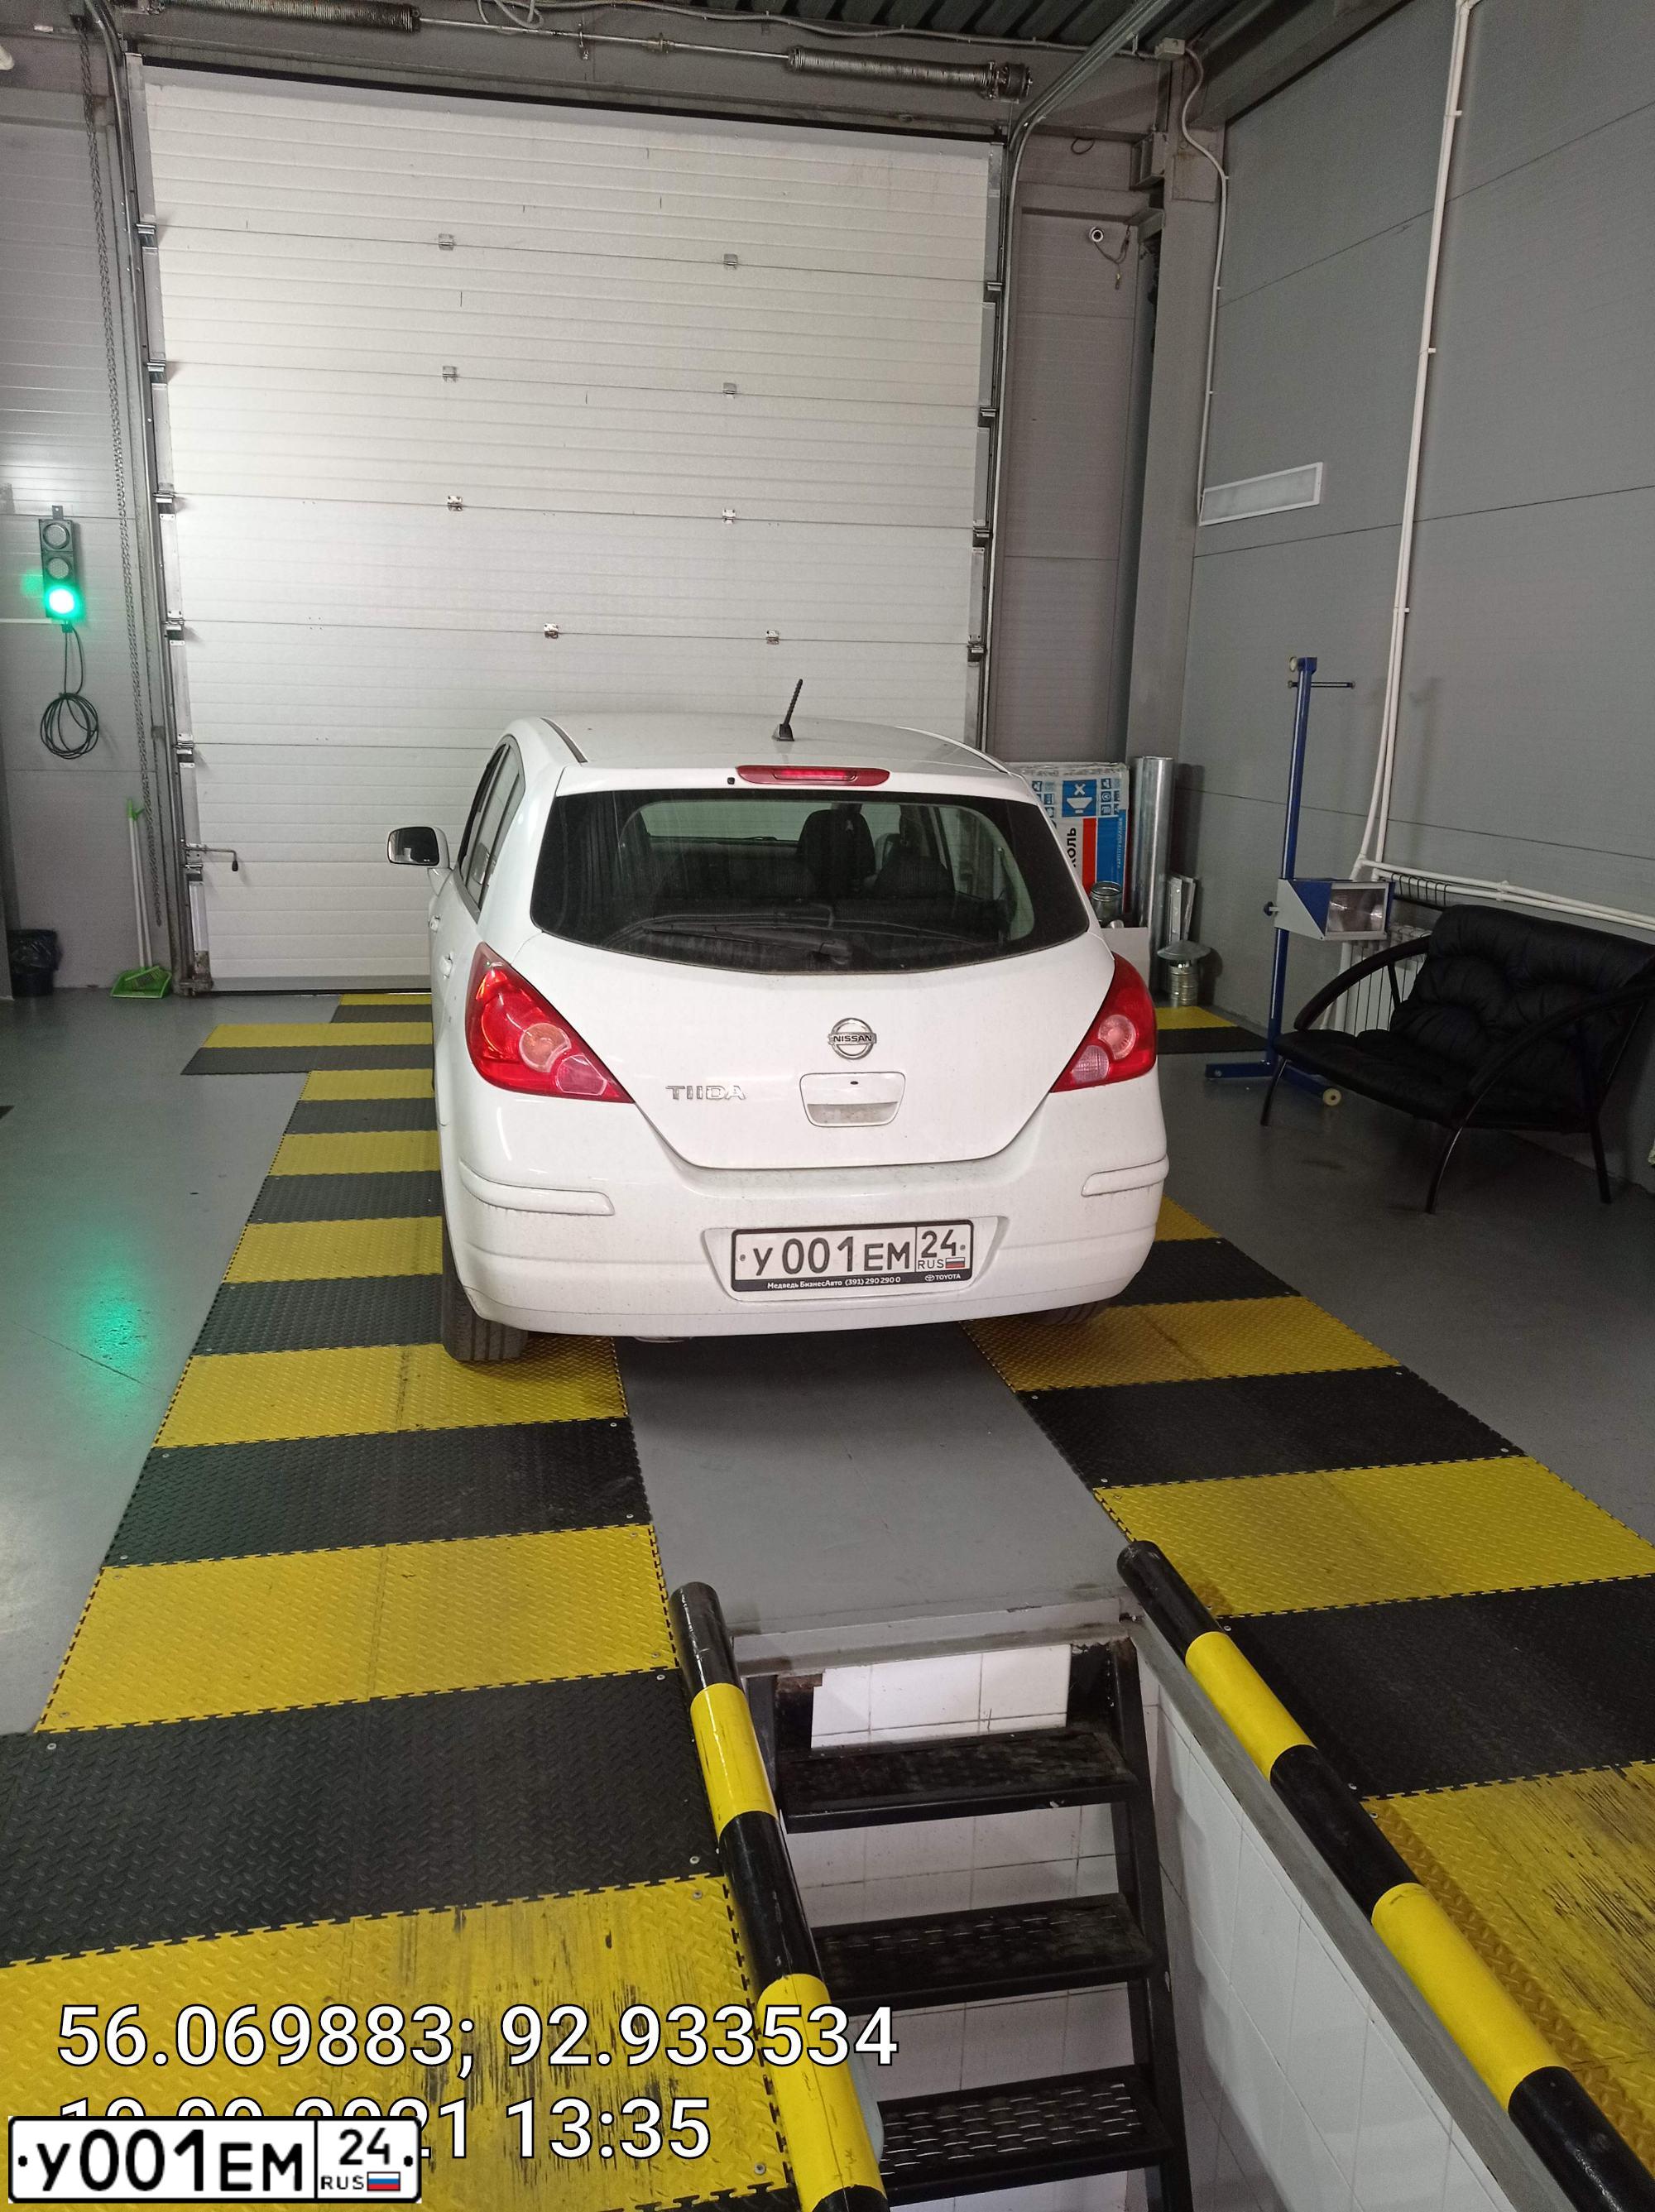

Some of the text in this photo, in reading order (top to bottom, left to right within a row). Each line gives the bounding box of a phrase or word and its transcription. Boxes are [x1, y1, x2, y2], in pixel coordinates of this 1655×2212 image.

[832, 1034, 872, 1043] NISSAN
[665, 1085, 746, 1100] TIIDA
[920, 1229, 957, 1258] 24
[917, 1258, 944, 1269] RUS
[800, 1279, 842, 1288] БизнесАвто
[845, 1278, 864, 1286] (391)
